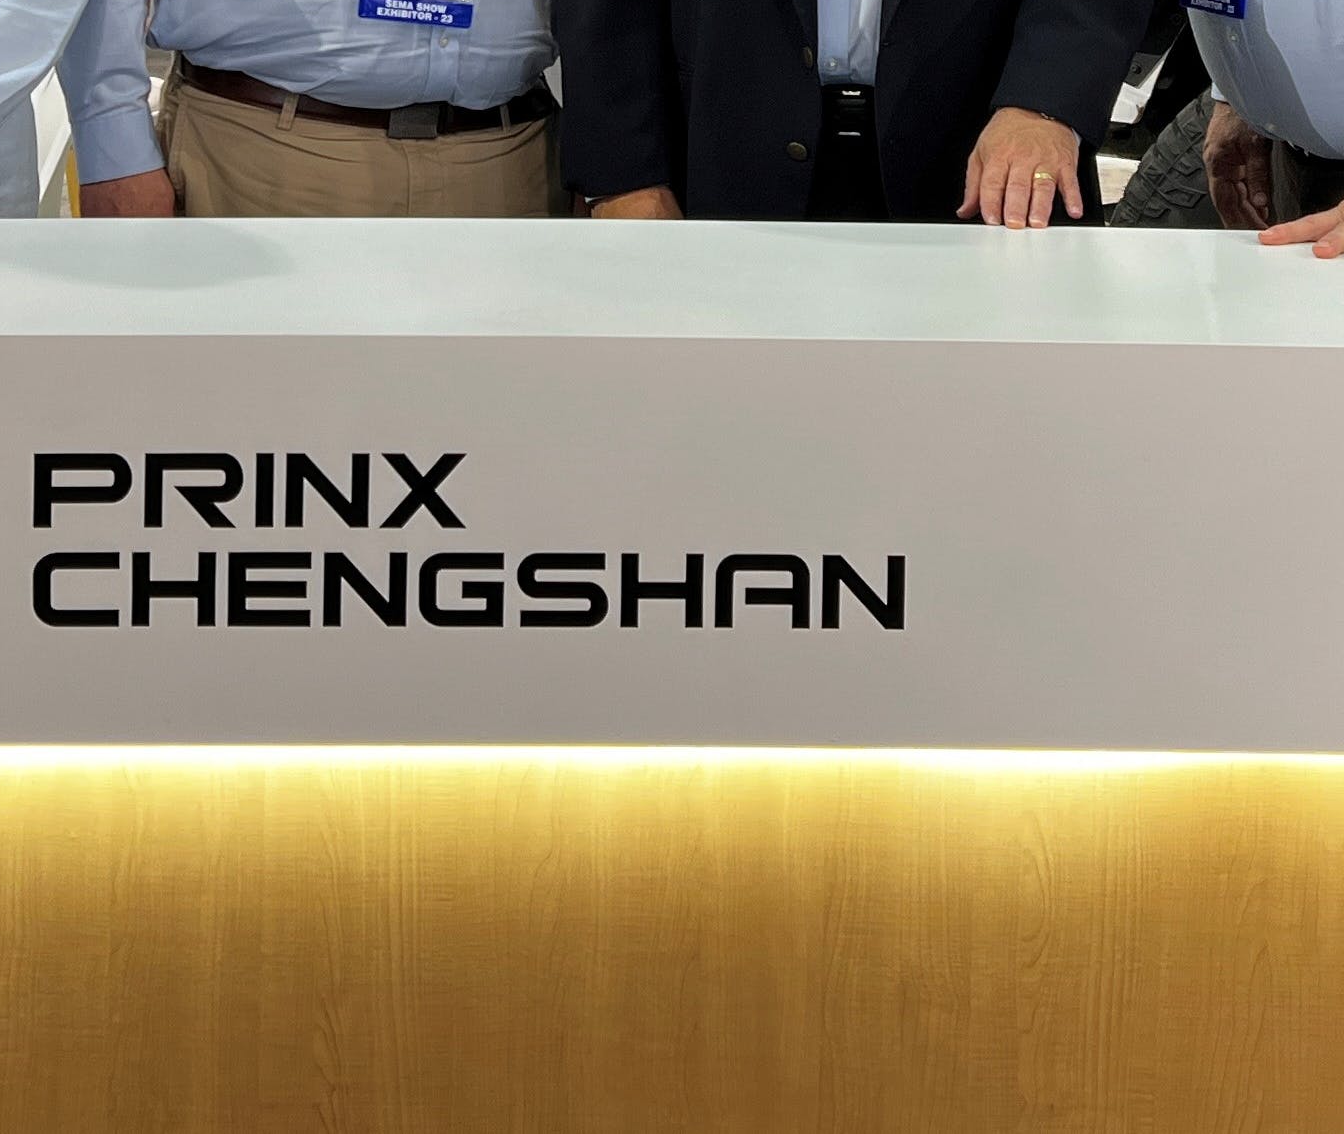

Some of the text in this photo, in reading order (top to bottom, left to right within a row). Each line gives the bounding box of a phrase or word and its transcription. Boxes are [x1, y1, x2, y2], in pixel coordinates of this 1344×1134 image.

[376, 7, 432, 22] EXHIBITOR
[440, 14, 453, 24] 23
[385, 0, 447, 14] SEMA SHOW
[33, 452, 466, 530] PRINX
[33, 551, 907, 631] CHENGSHAN
